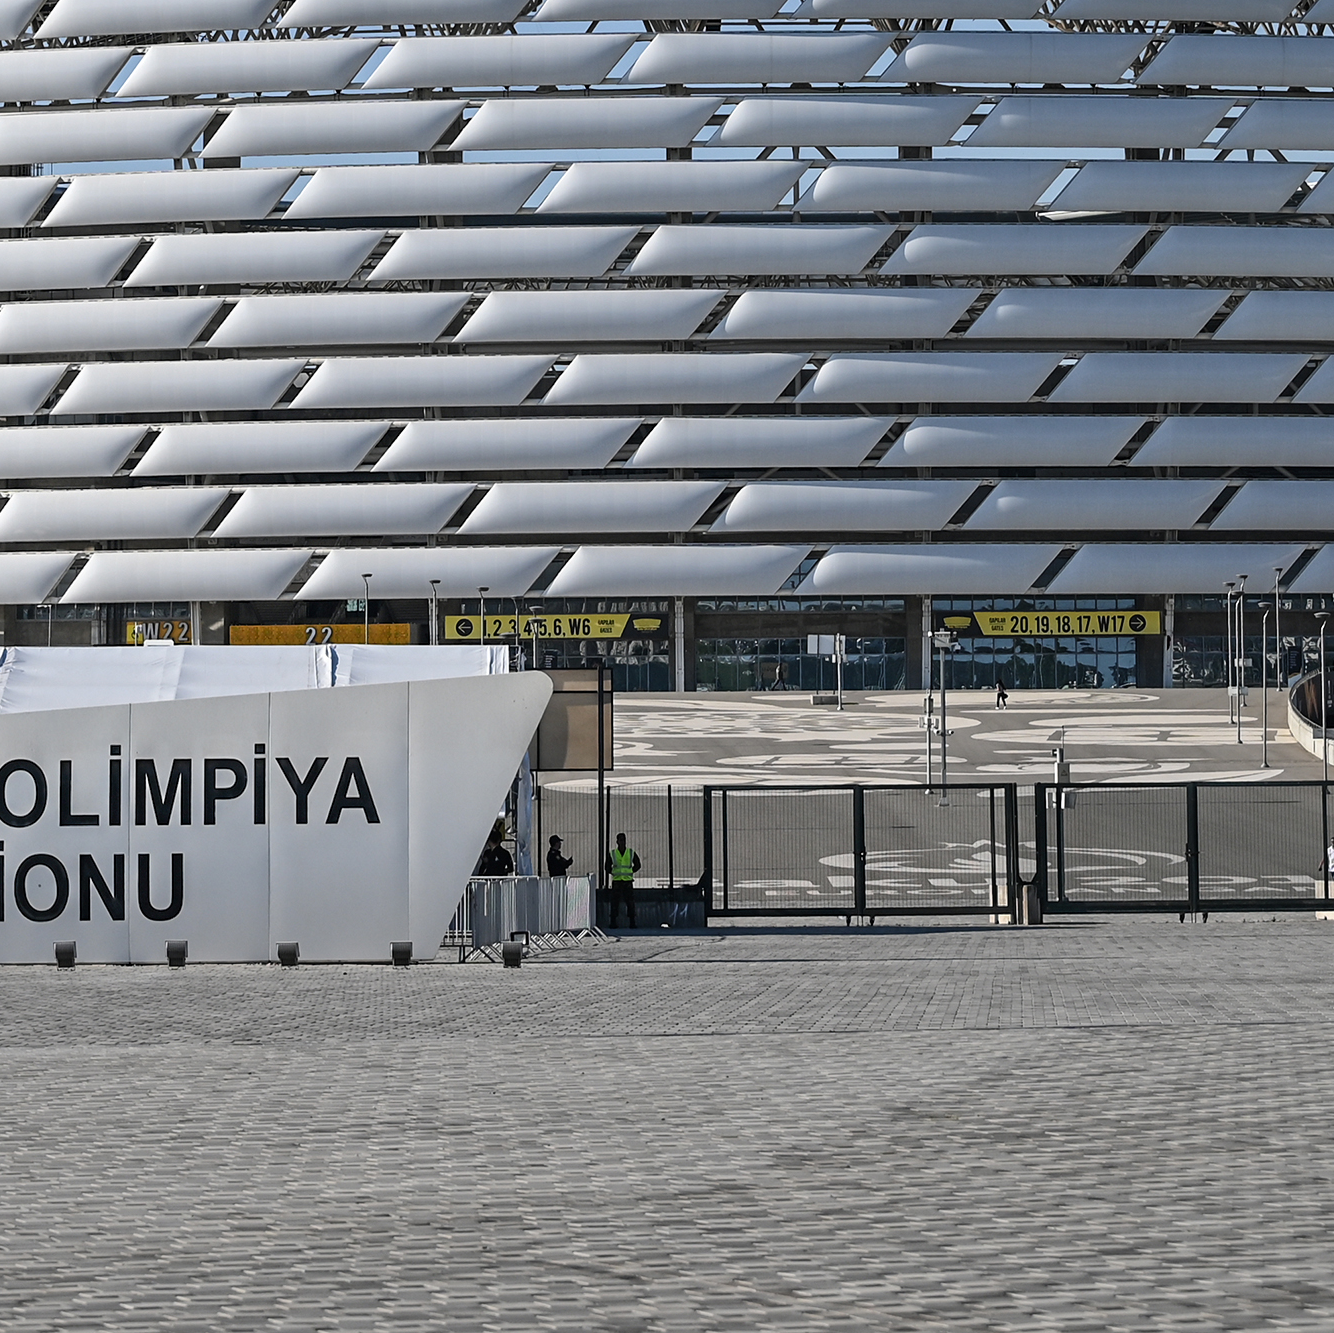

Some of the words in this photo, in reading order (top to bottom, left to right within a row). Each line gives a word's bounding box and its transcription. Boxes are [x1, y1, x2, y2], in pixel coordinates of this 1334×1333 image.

[568, 618, 591, 636] W6
[1097, 615, 1126, 633] W17
[305, 627, 332, 644] 22
